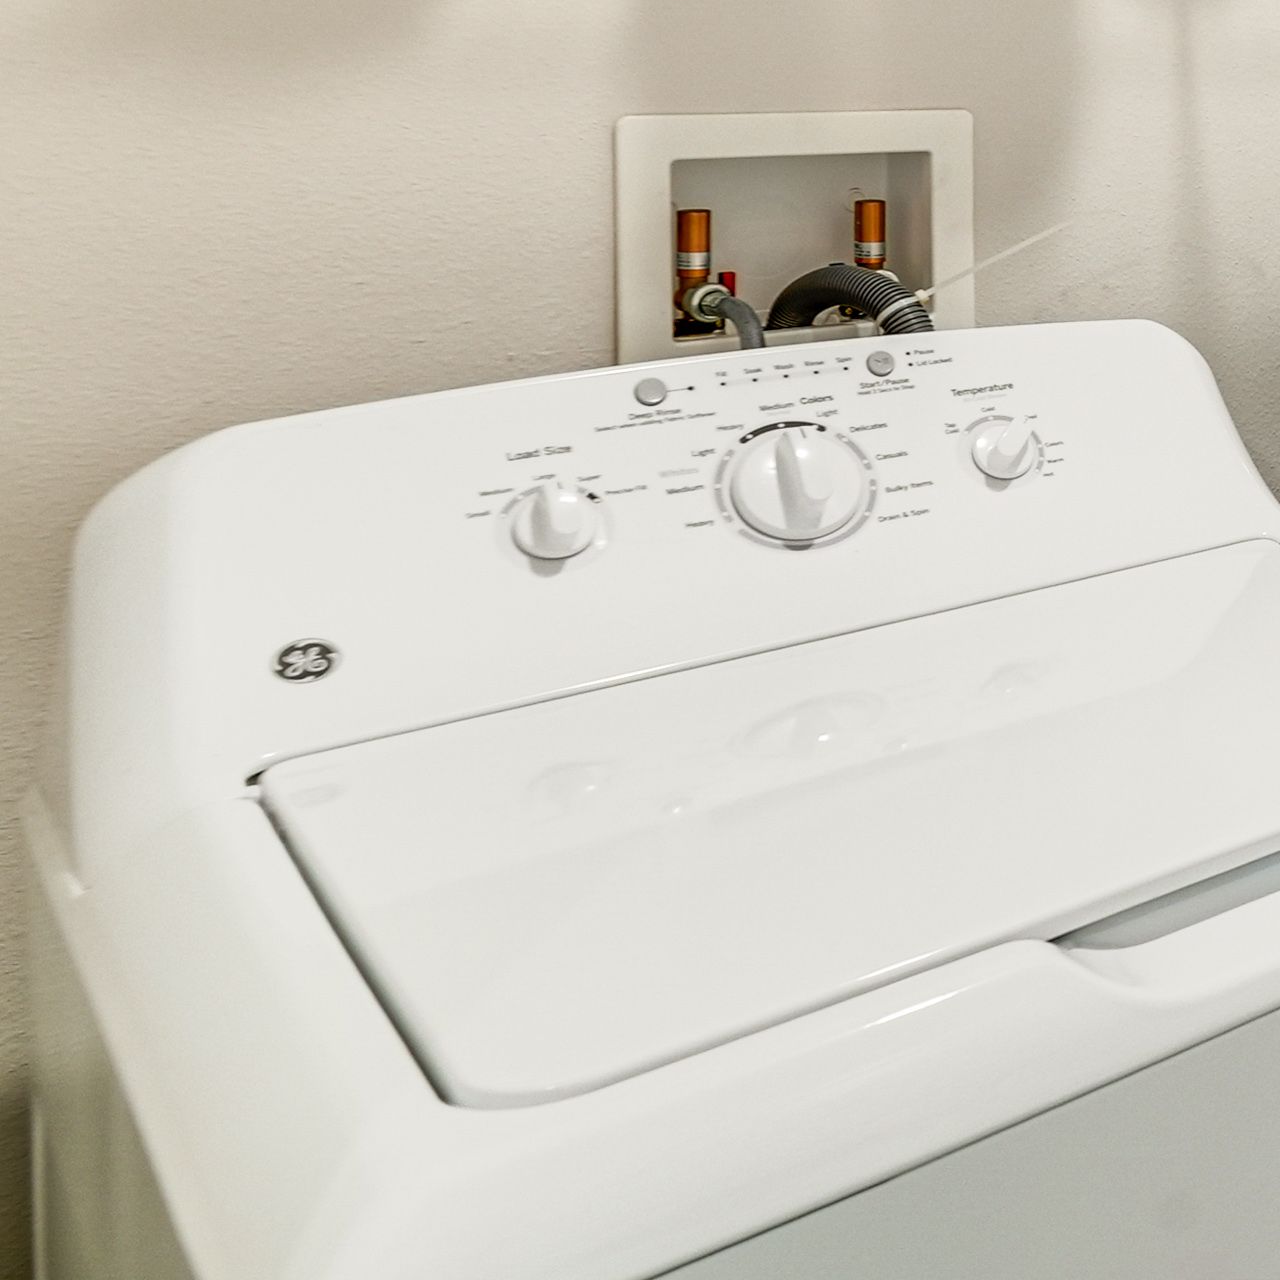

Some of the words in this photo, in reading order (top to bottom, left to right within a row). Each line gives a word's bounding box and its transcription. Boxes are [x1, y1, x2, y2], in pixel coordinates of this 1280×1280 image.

[859, 377, 911, 389] Start/Pause
[950, 382, 1014, 397] Temperature
[799, 394, 835, 405] Colors
[849, 422, 888, 433] Delicates
[506, 450, 541, 462] Load
[543, 445, 573, 456] Size
[885, 485, 908, 494] Bulky
